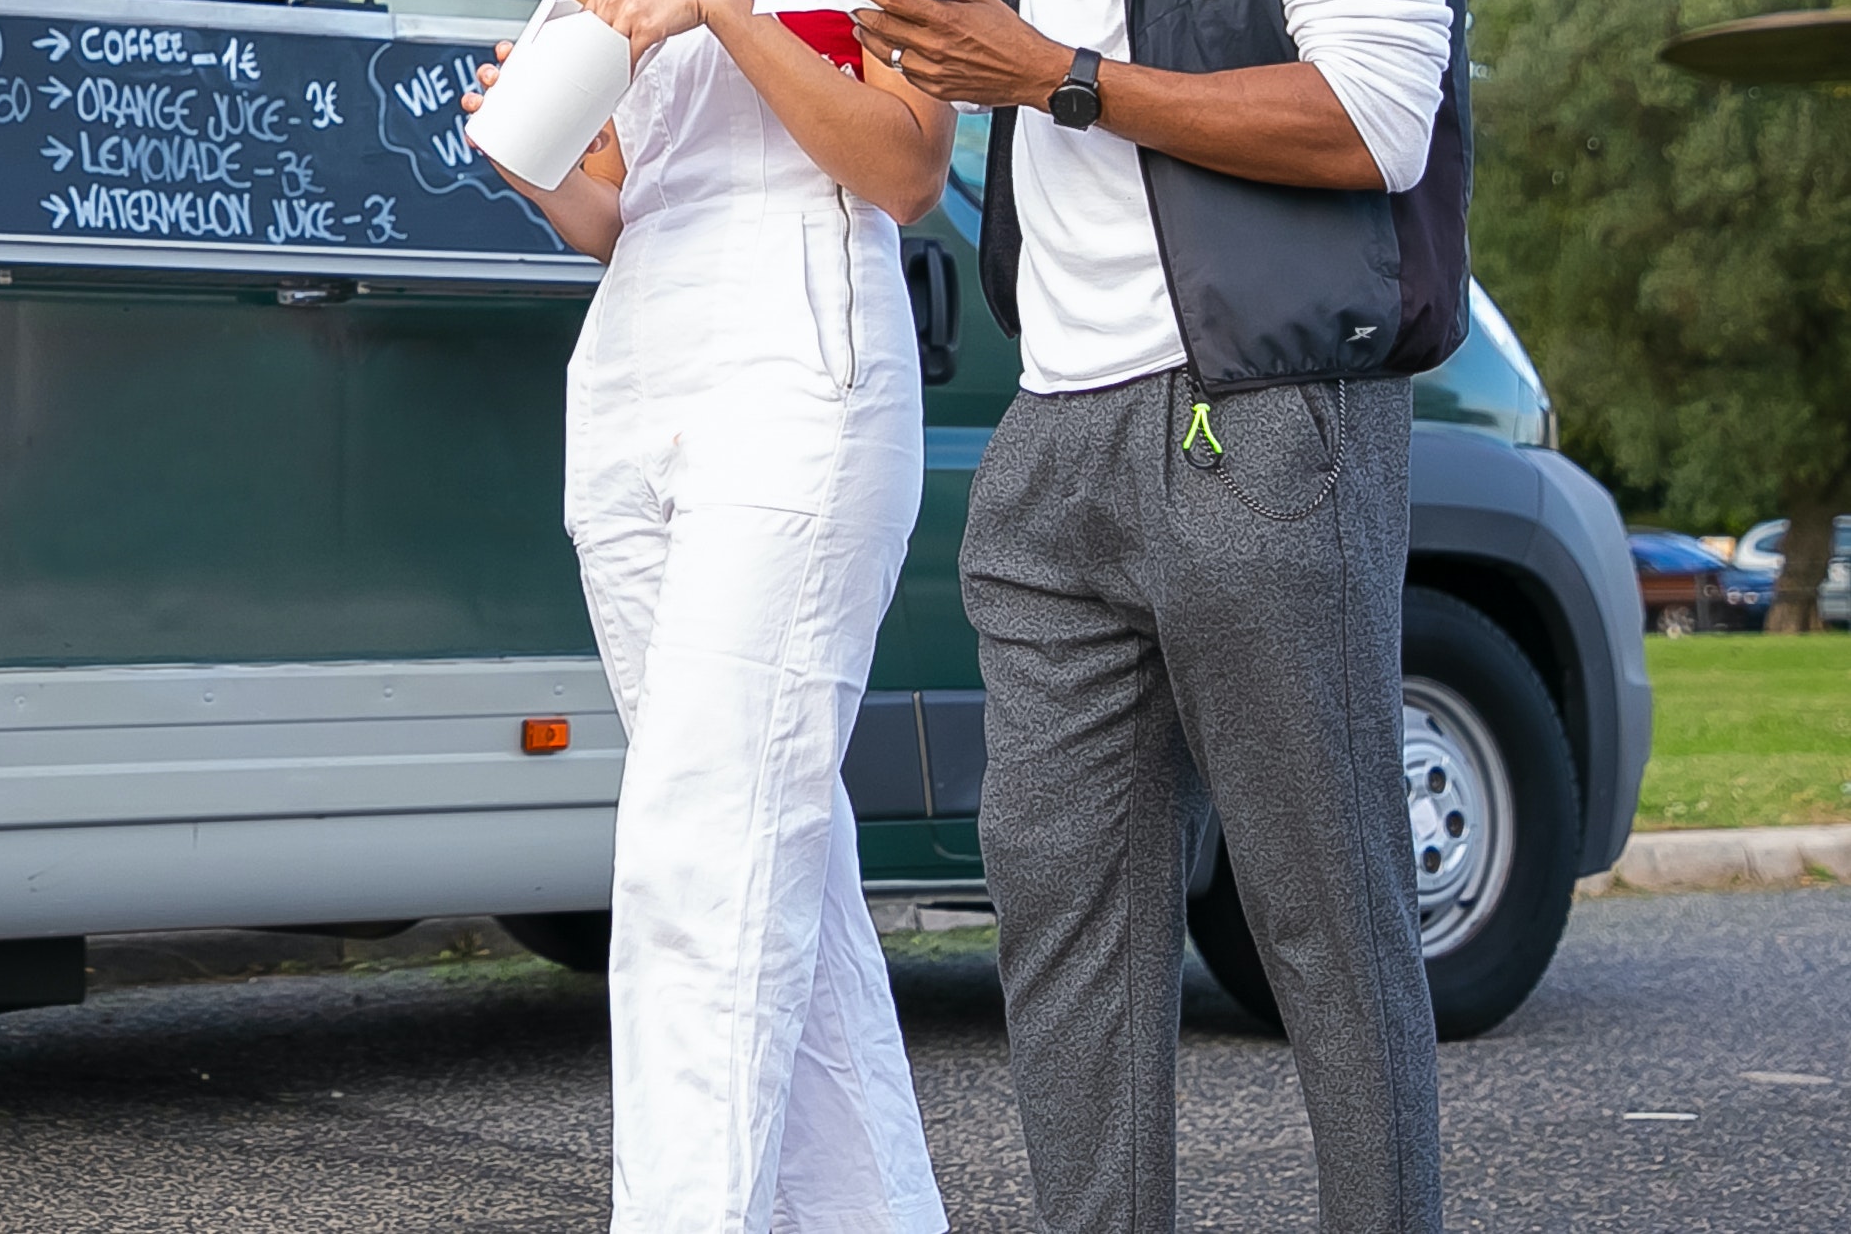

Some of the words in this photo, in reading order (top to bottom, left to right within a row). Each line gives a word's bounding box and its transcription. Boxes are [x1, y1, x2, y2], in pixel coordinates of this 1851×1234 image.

[80, 26, 188, 65] COFFEE
[75, 77, 199, 135] ORANGE
[395, 64, 455, 118] WE
[79, 131, 252, 189] LEMONADE
[68, 183, 253, 238] WATERMELON
